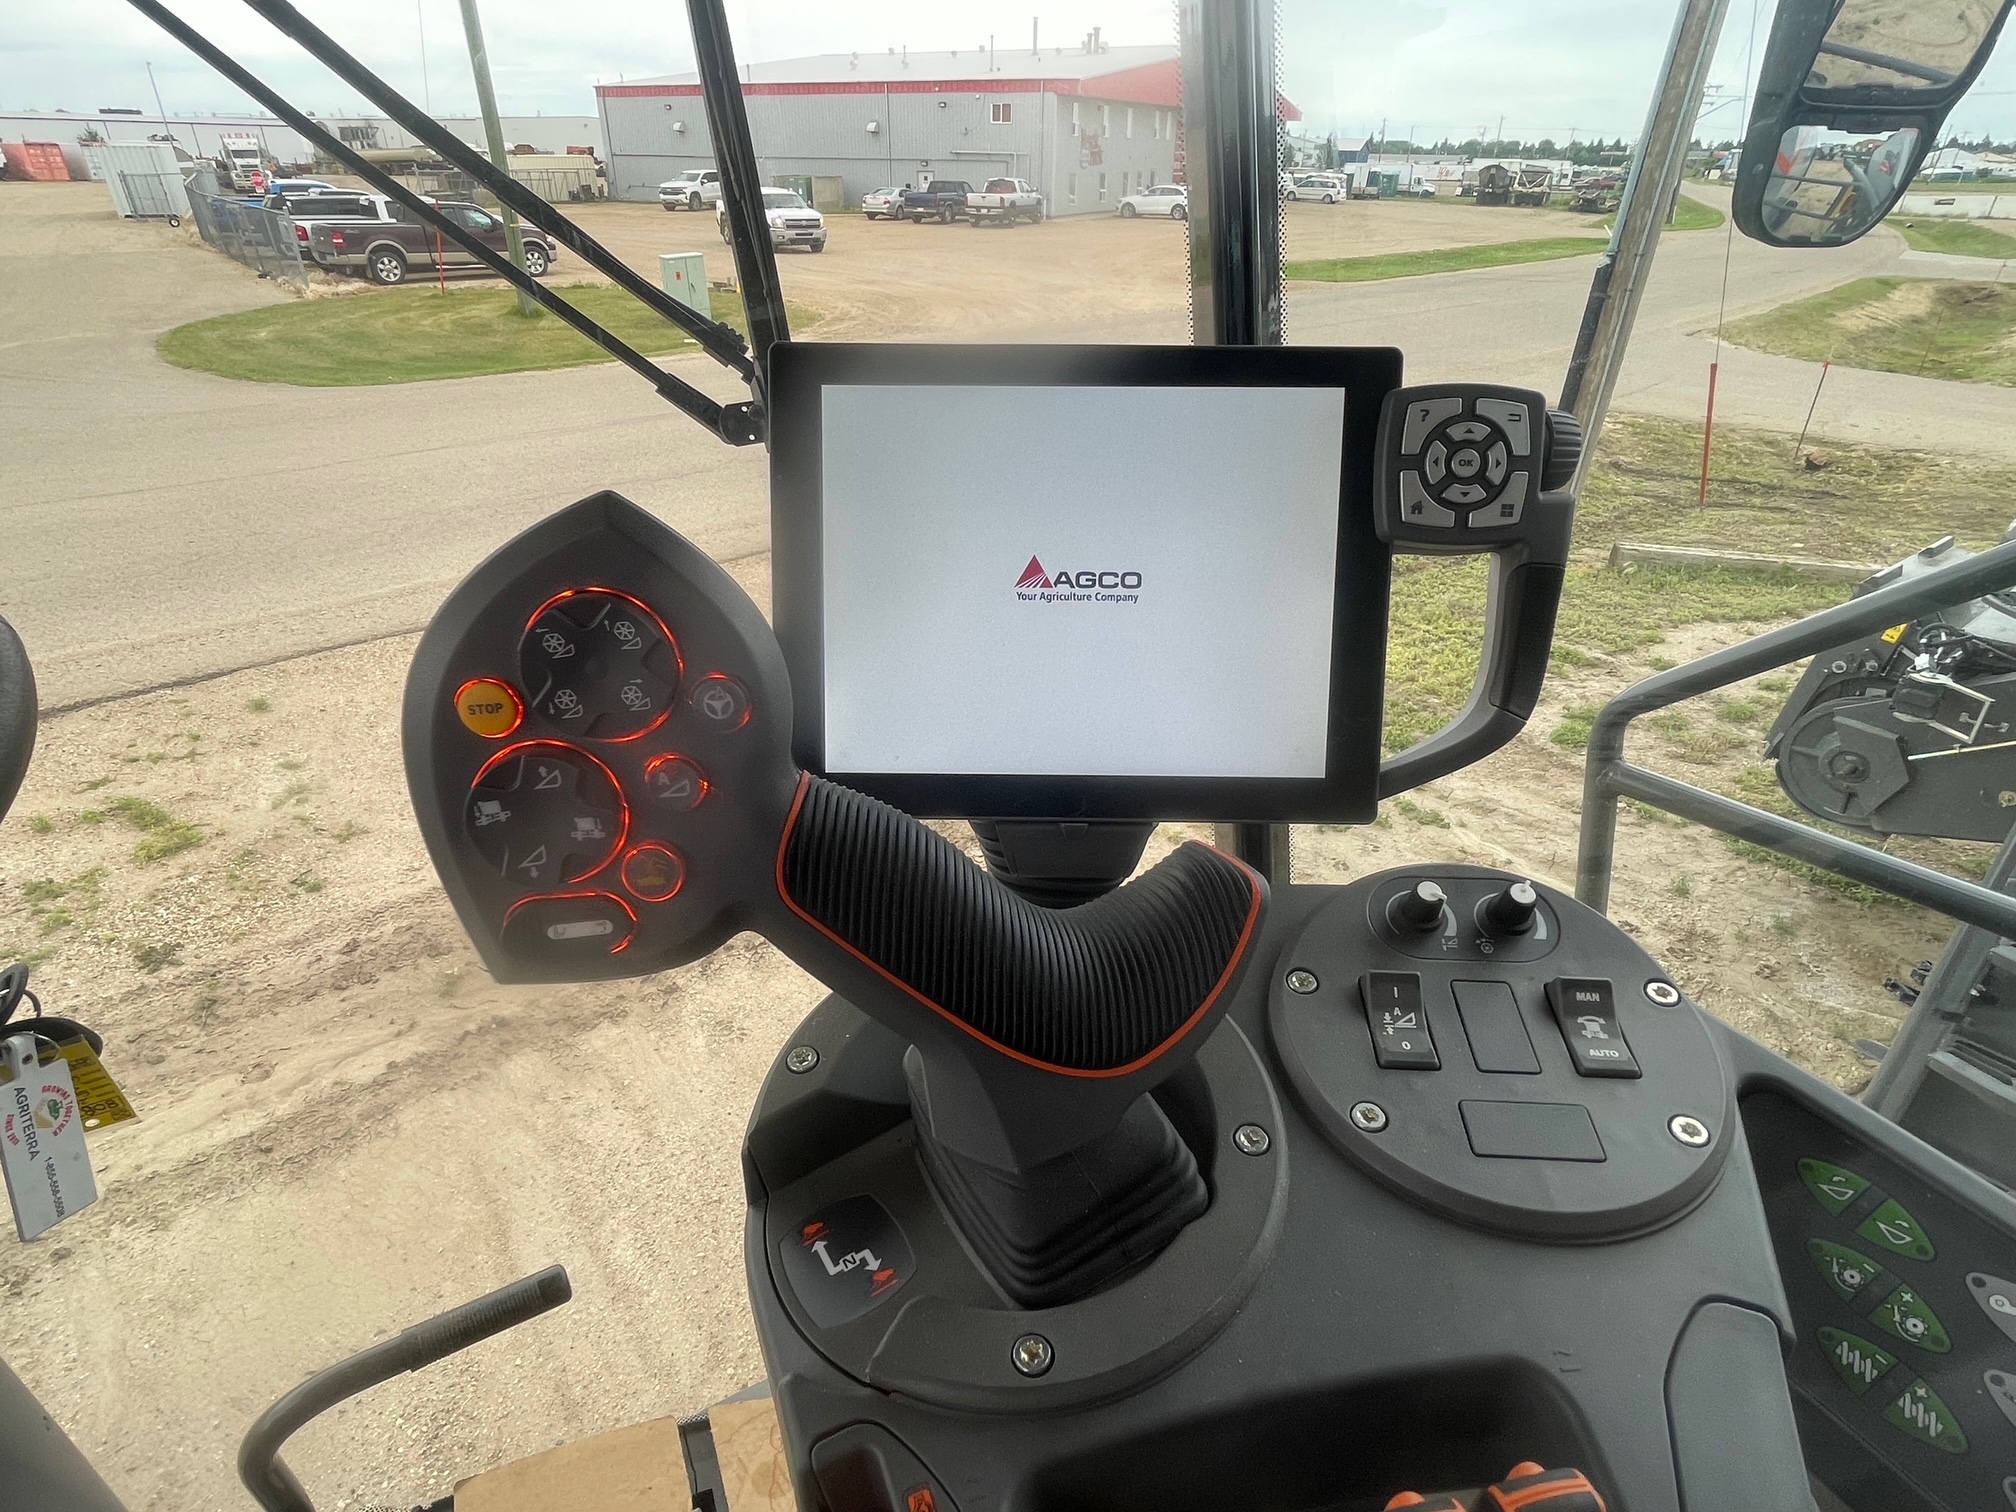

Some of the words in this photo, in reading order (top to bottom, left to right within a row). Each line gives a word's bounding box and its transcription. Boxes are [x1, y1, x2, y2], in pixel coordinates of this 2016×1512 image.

[1458, 459, 1474, 467] OK
[1053, 571, 1143, 589] AGCO
[1016, 591, 1037, 601] Your
[1039, 591, 1092, 603] Agriculture
[1094, 592, 1139, 604] Company
[467, 702, 504, 716] STOP
[1576, 991, 1600, 1002] MAN
[1588, 1048, 1619, 1058] AUTO
[14, 1087, 41, 1161] AGRITERRA
